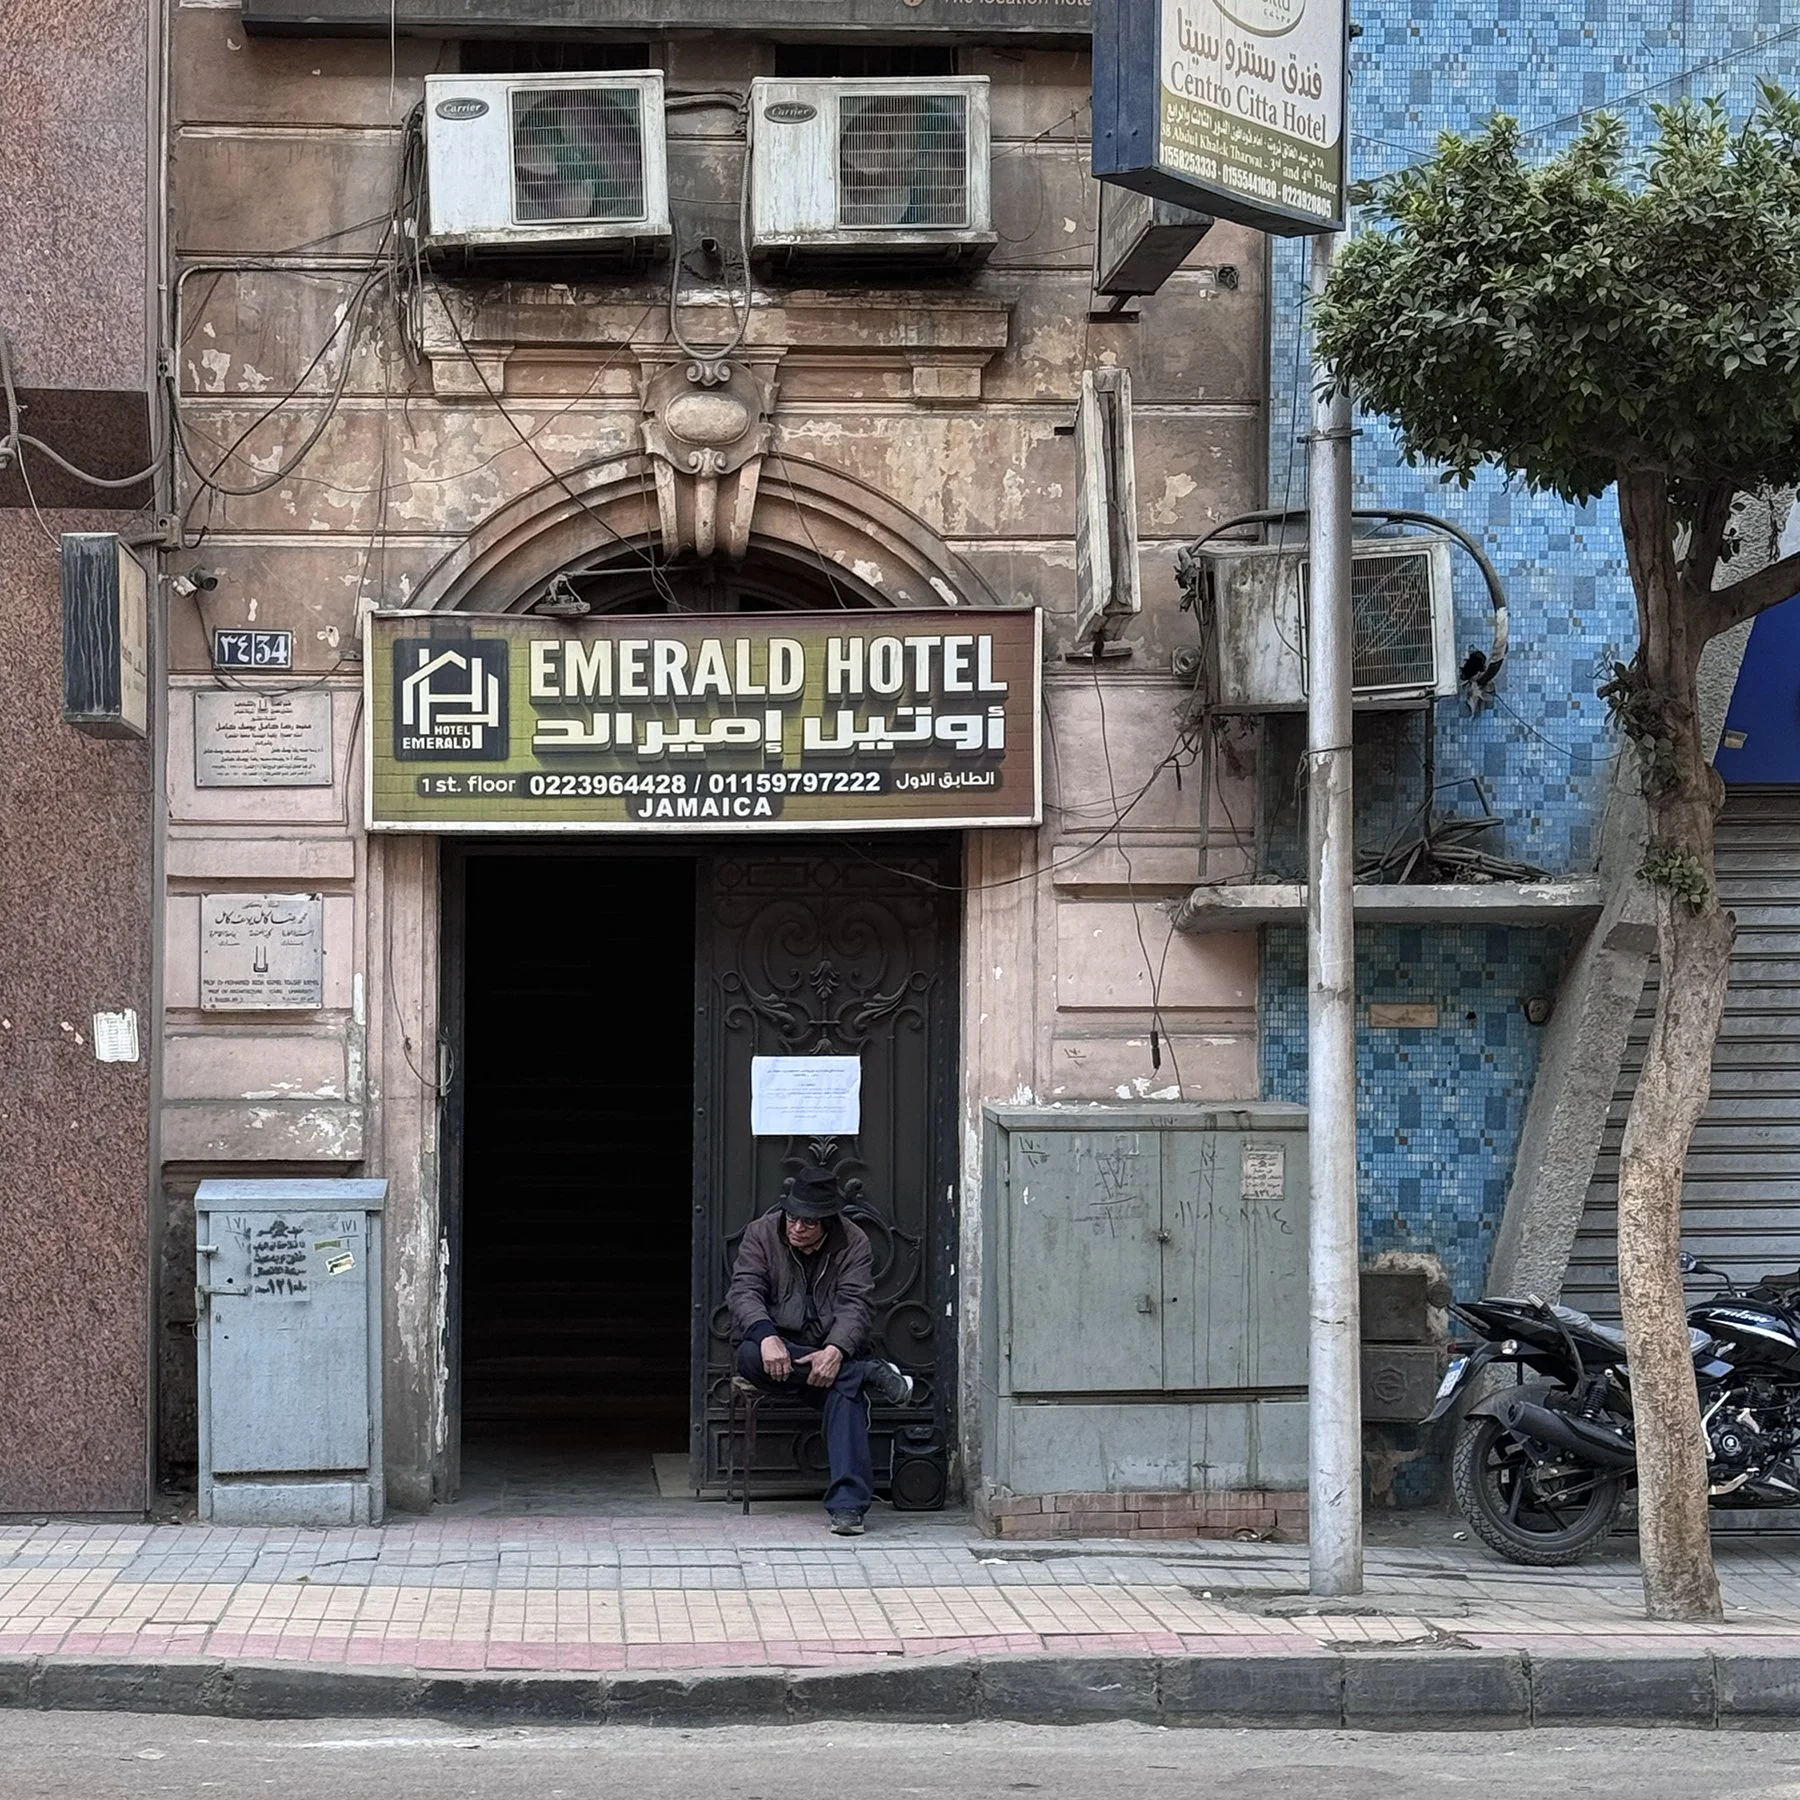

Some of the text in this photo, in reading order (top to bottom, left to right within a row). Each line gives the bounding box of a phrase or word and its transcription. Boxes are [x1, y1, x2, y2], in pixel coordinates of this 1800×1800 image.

[1177, 7, 1219, 66] سيتا
[1281, 53, 1322, 100] فندق
[443, 103, 482, 113] Carrier
[1170, 61, 1232, 109] Centro
[1236, 85, 1277, 126] Citta
[1282, 100, 1328, 144] Hotel
[1172, 126, 1198, 147] Abdul
[1282, 165, 1299, 181] and
[1314, 173, 1338, 195] Floor
[220, 635, 250, 663] ٣٤
[255, 635, 288, 664] 34
[529, 634, 1009, 697] EMERALD HOTEL
[402, 736, 471, 750] EMERALD
[434, 725, 471, 736] HOTEL
[532, 705, 1005, 755] أوتيل إميرالد
[421, 776, 517, 793] 1 st. floor
[529, 774, 686, 796] 0223964428
[708, 771, 881, 794] 01159797222
[896, 771, 995, 790] الطابق الاول
[638, 797, 773, 819] JAMAICA
